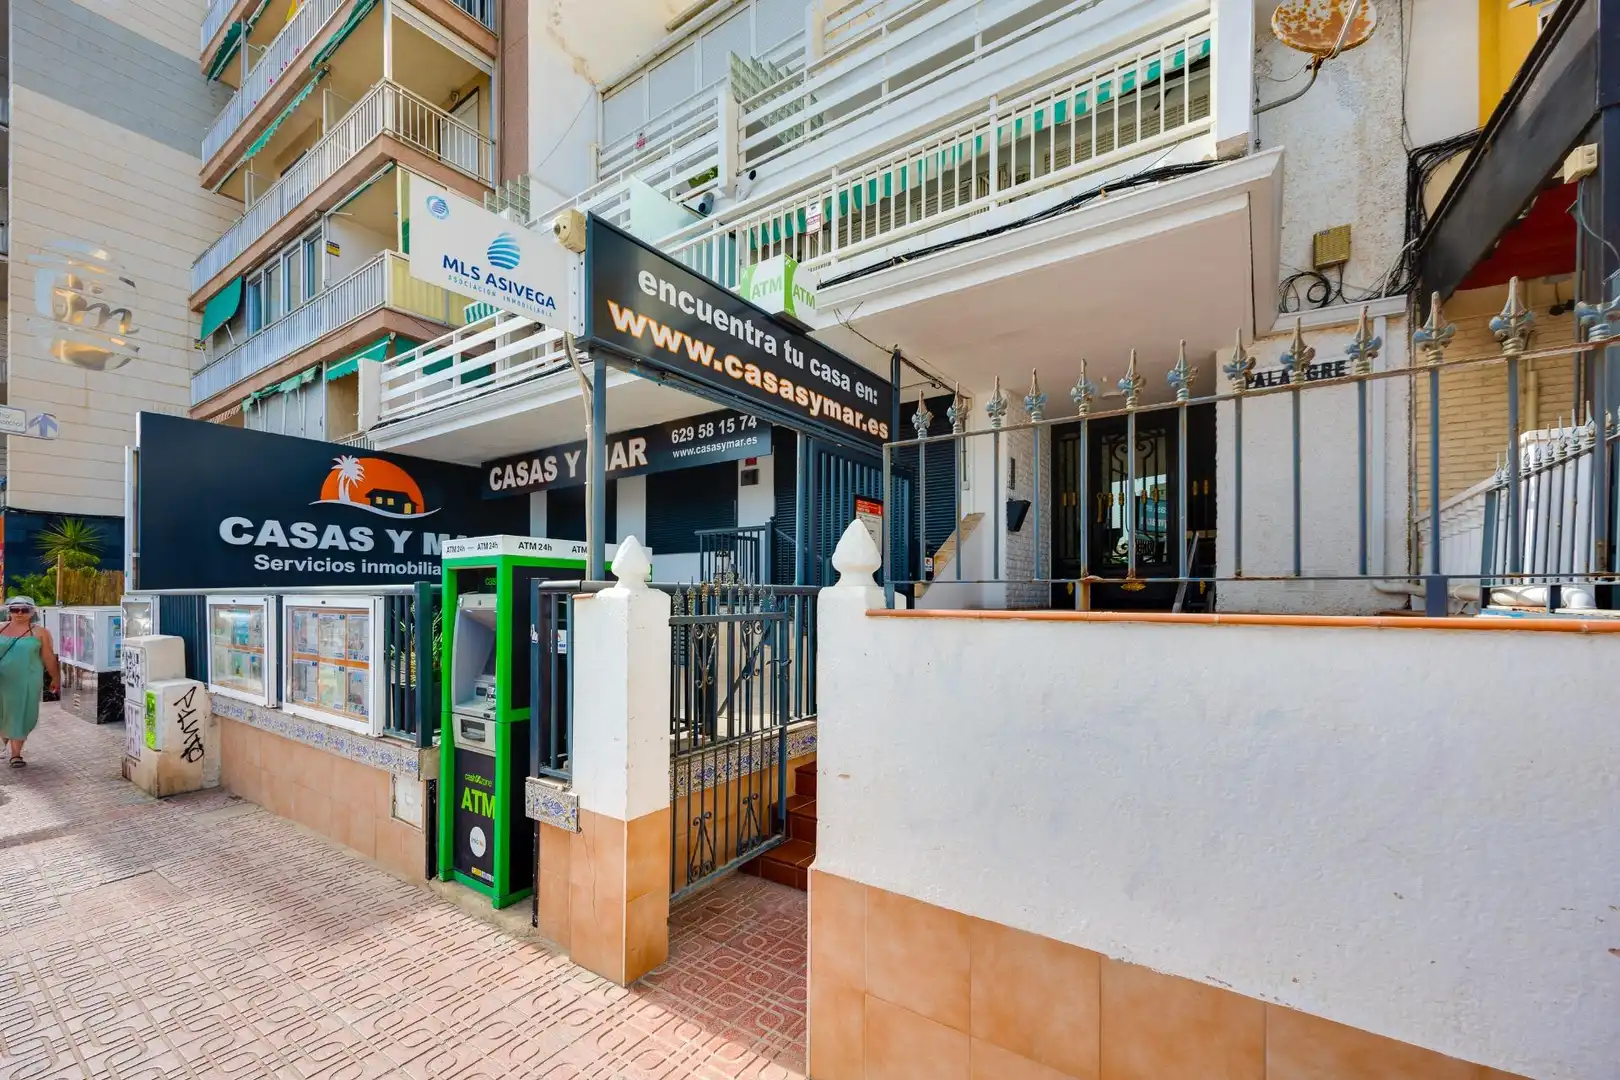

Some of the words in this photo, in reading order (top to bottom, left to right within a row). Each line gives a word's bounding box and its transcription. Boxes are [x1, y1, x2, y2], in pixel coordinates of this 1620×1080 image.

[442, 255, 481, 281] MLS
[485, 273, 556, 310] ASIVEGA
[752, 275, 783, 300] ATM
[792, 283, 816, 310] ATM
[502, 295, 553, 317] INMOBILIARIA
[638, 269, 777, 357] encuentra
[784, 339, 804, 369] tu
[810, 358, 851, 393] casa
[855, 381, 878, 405] en:
[607, 299, 889, 441] www.casasymar.es
[1245, 360, 1347, 390] PALAGRE
[671, 425, 694, 444] 629
[698, 422, 714, 440] 58
[718, 417, 735, 435] 15
[740, 415, 757, 431] 74
[672, 435, 758, 459] www.casasymar.es
[489, 455, 558, 491] CASAS
[564, 450, 581, 478] Y
[605, 437, 648, 471] AR
[219, 516, 375, 552] CASAS
[385, 529, 413, 555] Y
[446, 545, 457, 554] ATM
[477, 542, 489, 551] ATM
[489, 541, 498, 550] 24h
[518, 541, 537, 550] ATM
[538, 543, 552, 551] 24h
[571, 545, 588, 554] ATM
[253, 554, 356, 573] Servicios
[361, 559, 442, 577] inmobilia
[461, 786, 496, 820] ATM
